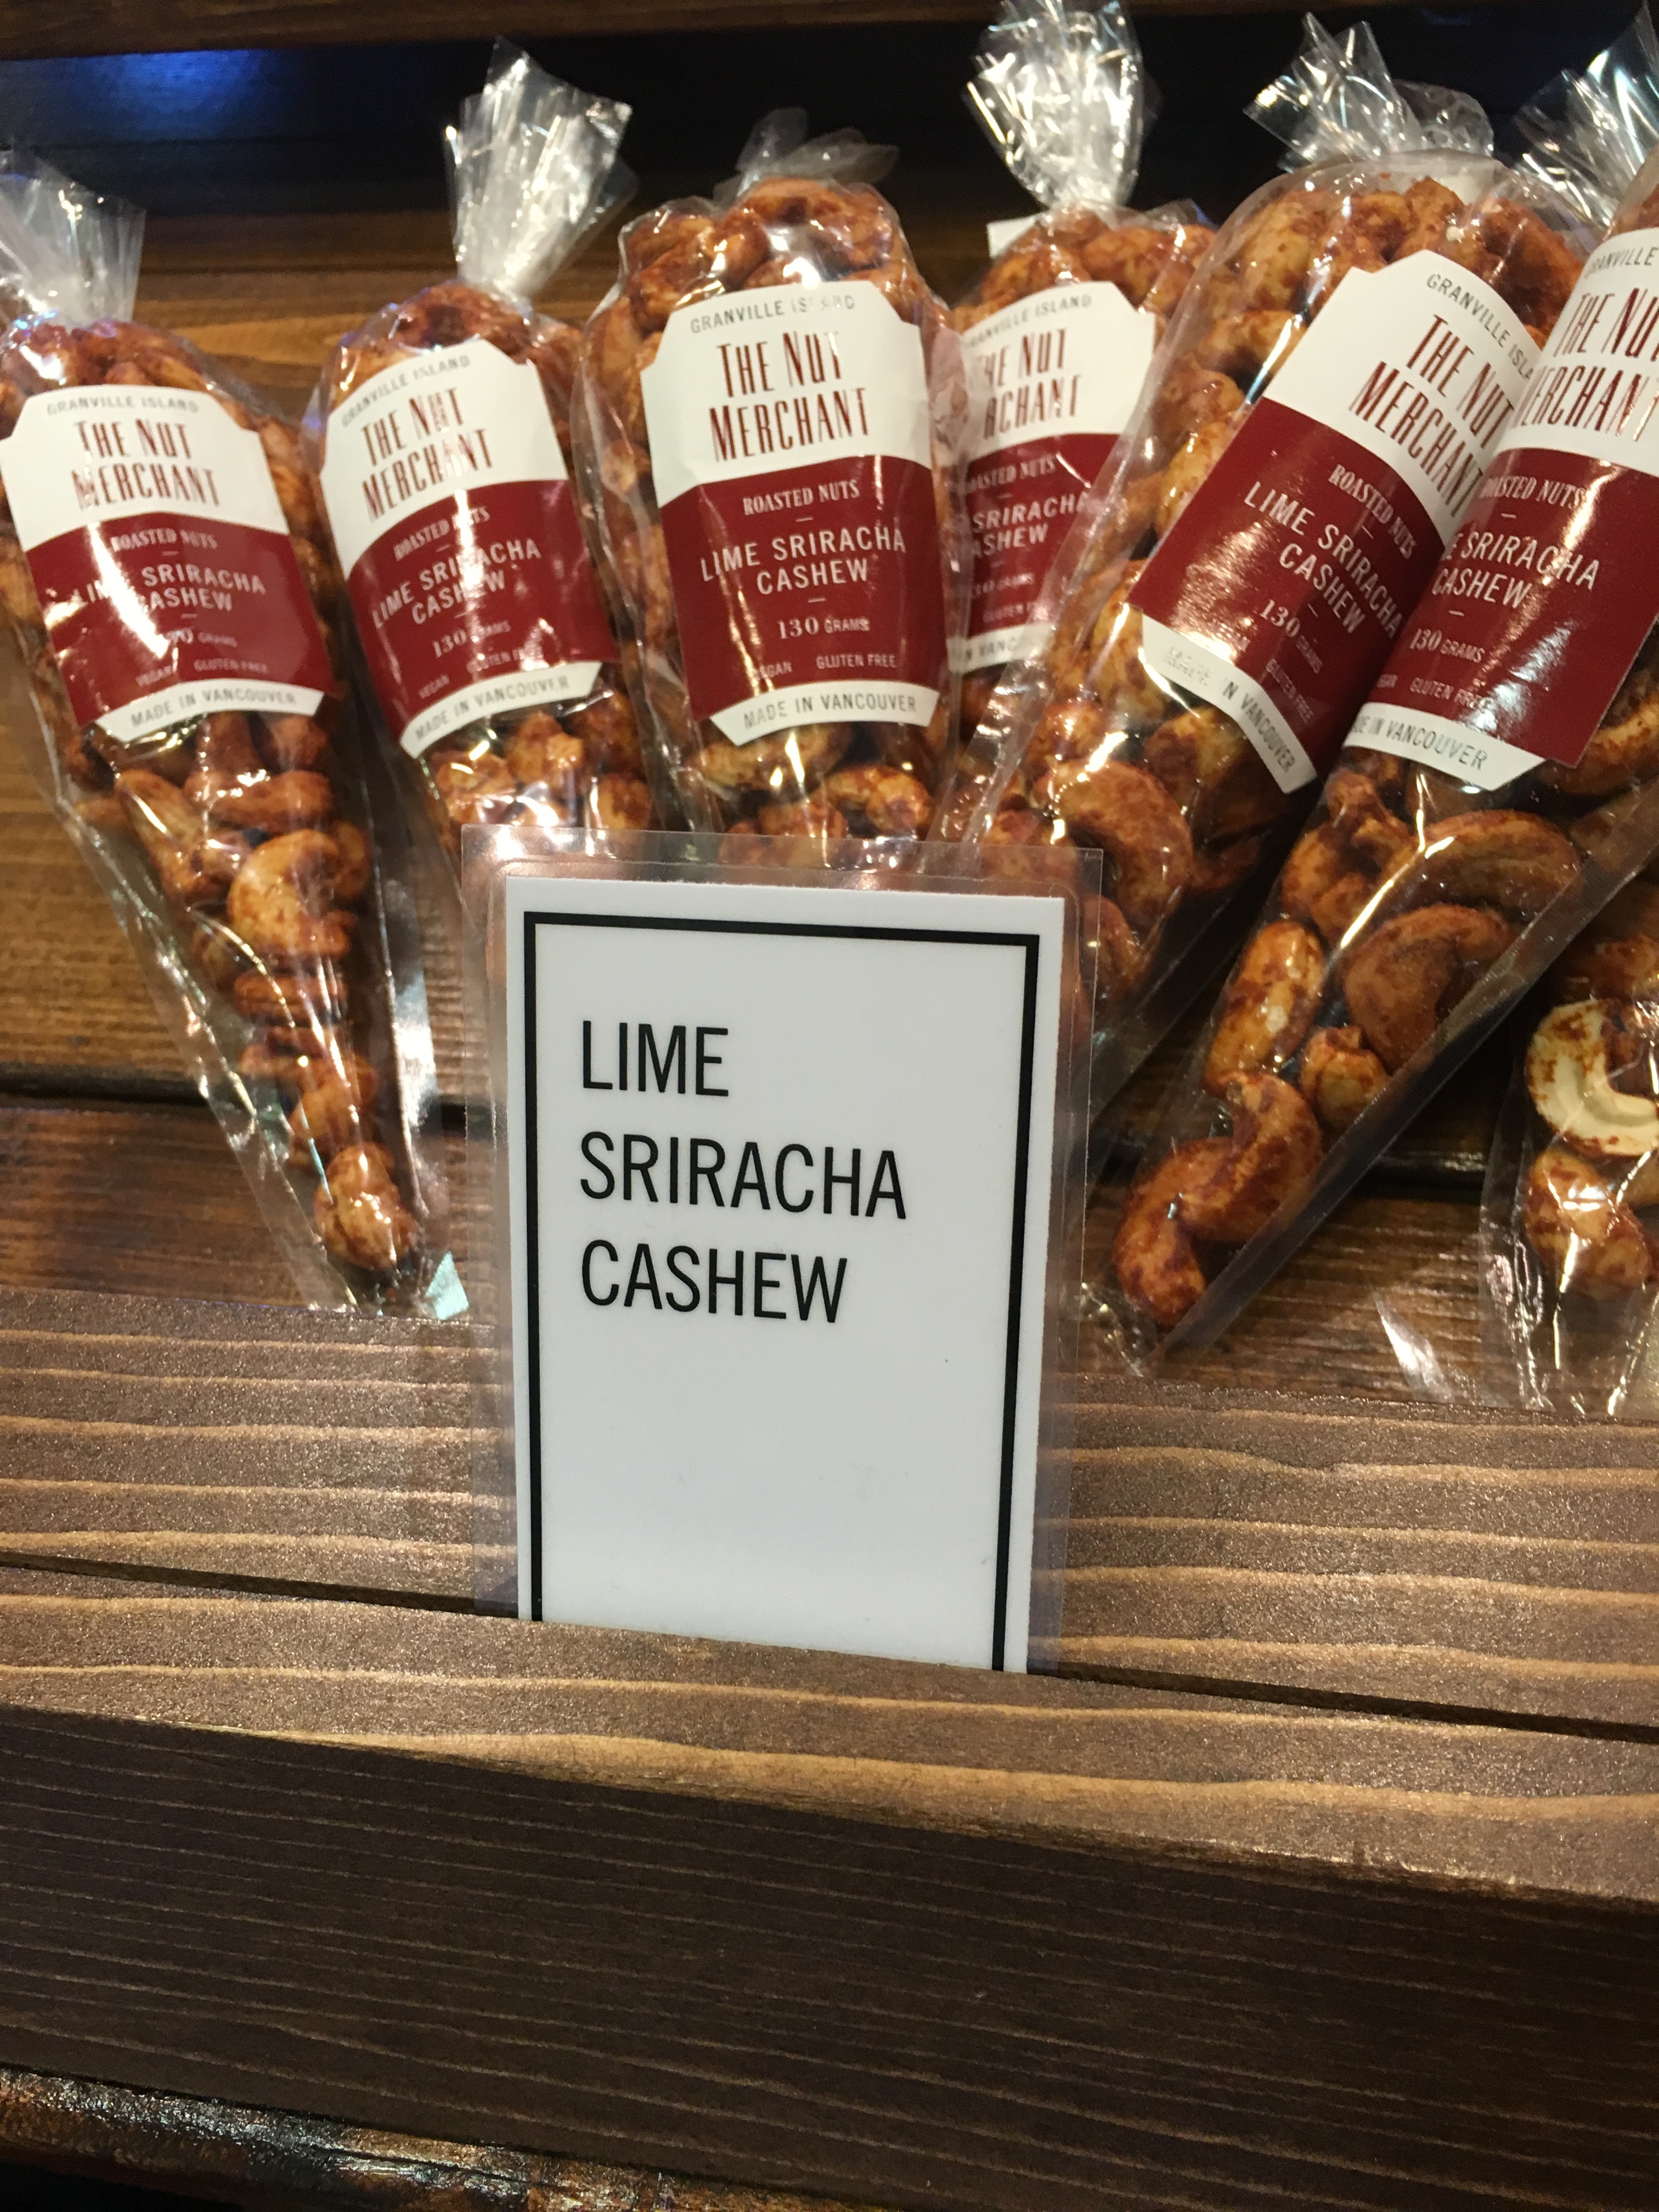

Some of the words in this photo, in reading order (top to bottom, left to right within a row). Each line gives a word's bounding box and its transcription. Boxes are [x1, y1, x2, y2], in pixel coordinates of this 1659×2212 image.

[690, 300, 785, 334] GRANVILLE
[791, 294, 856, 313] ISAND
[1035, 294, 1093, 318] ISLAND
[1426, 273, 1511, 348] GRANVILLE
[1508, 343, 1534, 380] ISLA
[1554, 292, 1615, 358] THE
[1601, 287, 1659, 362] NU
[413, 354, 471, 381] ISLAND
[716, 341, 775, 398] THE
[782, 331, 842, 387] NUT
[1017, 327, 1068, 380] NUT
[47, 395, 135, 415] GRANVILLE
[140, 396, 199, 414] ISLAND
[983, 373, 1083, 441] RCHANT
[1406, 314, 1475, 398] THE
[1455, 361, 1515, 449] NUT
[73, 420, 132, 459] THE
[135, 418, 192, 460] NUT
[361, 409, 407, 467] THE
[709, 387, 869, 462] MERCHANT
[1348, 360, 1484, 518] MERCHANT
[70, 462, 221, 511] MERCHANT
[362, 427, 493, 523] MERCHANT
[742, 486, 814, 516] ROASTED
[818, 478, 861, 503] NUTS
[1328, 464, 1395, 524] ROASTED
[1536, 479, 1587, 510] NUTS
[141, 563, 267, 595] SRIRACHA
[700, 541, 761, 582] LIME
[771, 525, 907, 561] SRIRACHA
[757, 557, 868, 595] CASHEW
[1243, 481, 1316, 537] LIME
[1317, 524, 1403, 640] SRIRACHA
[1460, 532, 1600, 590] SRIRACHA
[138, 586, 233, 612] ASHEW
[371, 580, 415, 629] LIME
[419, 538, 542, 591] SRIACHA
[411, 569, 505, 624] CASHW
[1279, 542, 1366, 634] CASHEW
[1432, 567, 1533, 609] CASHEW
[432, 629, 467, 658] 130
[777, 616, 820, 640] 130
[823, 615, 870, 634] GRAMS
[1260, 599, 1301, 638] 130
[816, 653, 864, 670] GLUTEN
[867, 652, 897, 668] FREE
[1410, 628, 1442, 651] 130
[1440, 639, 1486, 663] GRAMS
[130, 702, 171, 727] MADE
[178, 691, 198, 709] IN
[201, 688, 297, 706] VANCOUVER
[453, 700, 470, 719] IN
[474, 675, 570, 707] VANCOUVER
[743, 700, 788, 730] MADE
[795, 696, 814, 713] IN
[820, 693, 917, 713] VANCOUVER
[1240, 693, 1295, 774] VANCOUVER
[1385, 719, 1488, 770] VANCOUVER
[582, 1020, 729, 1097] LIME
[580, 1131, 907, 1220] SRIRACHA
[581, 1239, 848, 1324] CASHEW
